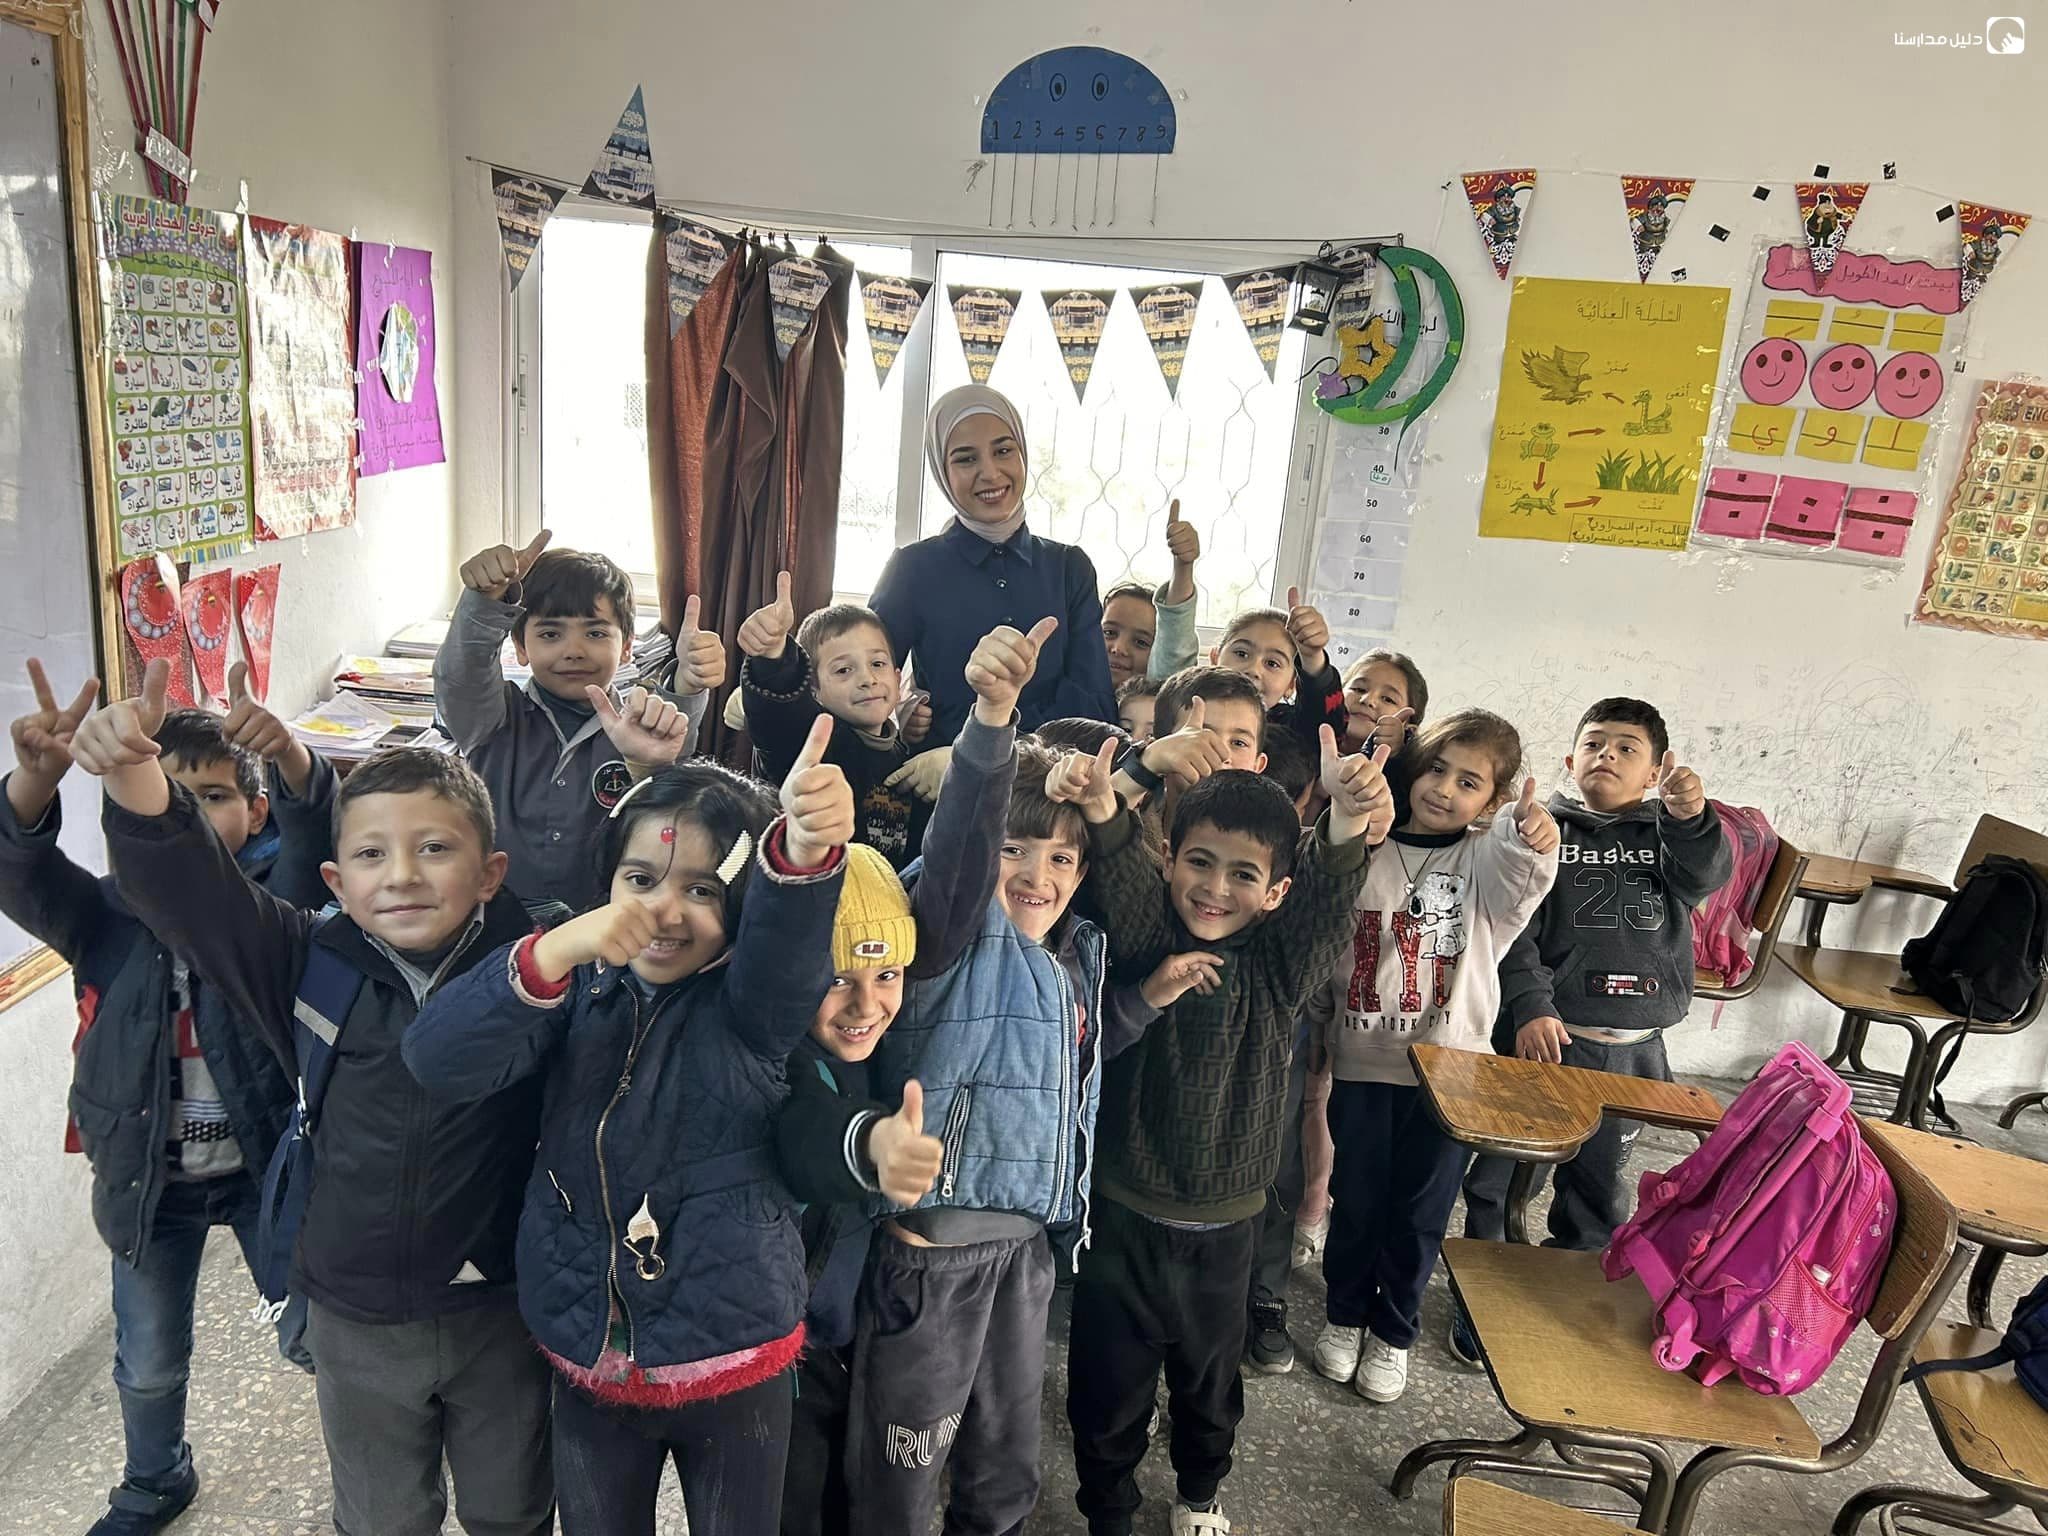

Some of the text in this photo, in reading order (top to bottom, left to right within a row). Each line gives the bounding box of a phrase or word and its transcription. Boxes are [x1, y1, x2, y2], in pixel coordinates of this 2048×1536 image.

[991, 121, 1166, 142] 1 2 3 4 5 6 7 8 9
[188, 217, 217, 238] حروف
[125, 377, 145, 391] سيارة
[1385, 391, 1397, 399] 20
[136, 399, 148, 411] ط
[124, 417, 148, 433] طائرة
[1378, 427, 1390, 435] 30
[1751, 424, 1778, 450] ي
[1814, 426, 1838, 447] و
[1373, 465, 1384, 473] 40
[143, 478, 151, 496] م
[1366, 499, 1378, 507] 50
[1995, 515, 2012, 532] N
[1360, 535, 1372, 543] 60
[1353, 572, 1365, 580] 70
[1348, 608, 1360, 616] 80
[1337, 646, 1349, 655] 90
[1560, 841, 1655, 865] Baske
[1573, 867, 1665, 931] 23
[1381, 1015, 1417, 1032] YORK
